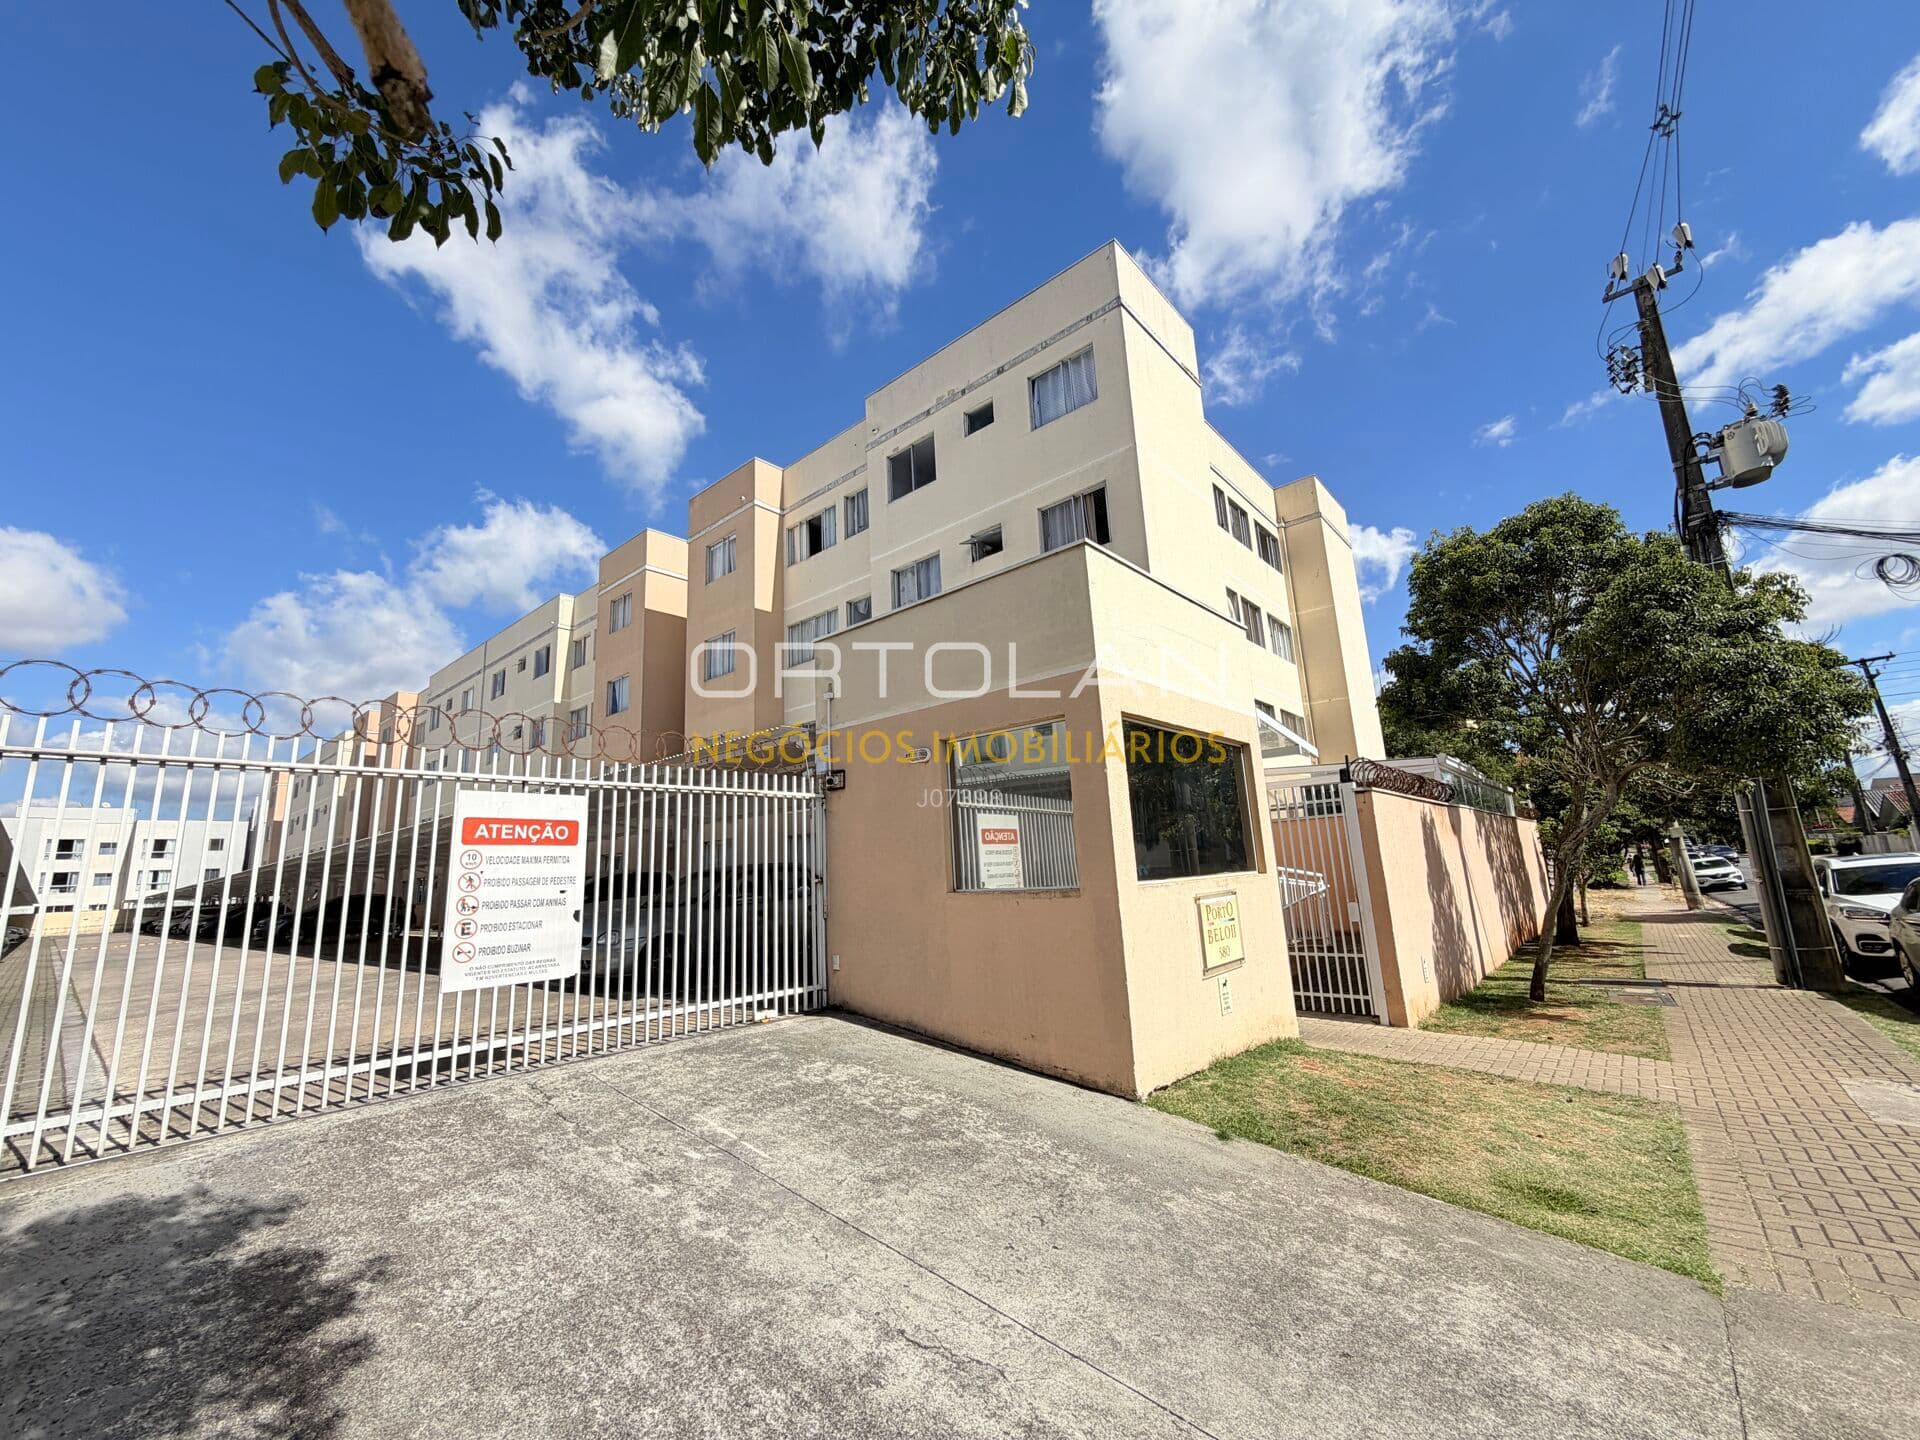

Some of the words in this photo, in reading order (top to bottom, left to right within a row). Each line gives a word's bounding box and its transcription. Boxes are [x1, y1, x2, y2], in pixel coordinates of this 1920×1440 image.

[474, 822, 569, 843] ATENÇÃO
[467, 853, 477, 861] 10
[485, 855, 520, 865] VELOCIDADE
[542, 855, 570, 864] PERMITIDA
[483, 878, 511, 887] PROIBIDO
[512, 877, 541, 887] PASSAGEM
[541, 876, 549, 885] DE
[549, 875, 577, 885] PEDESTRE
[481, 900, 509, 910] PROIBIDO
[510, 899, 531, 909] PASSAR
[532, 898, 545, 907] COM
[545, 897, 567, 906] ANIMAIS
[480, 923, 507, 933] PROIBIDO
[508, 920, 543, 931] ESTACIONAR
[478, 945, 506, 956] PROIBIDO
[506, 943, 531, 954] BUZINAR
